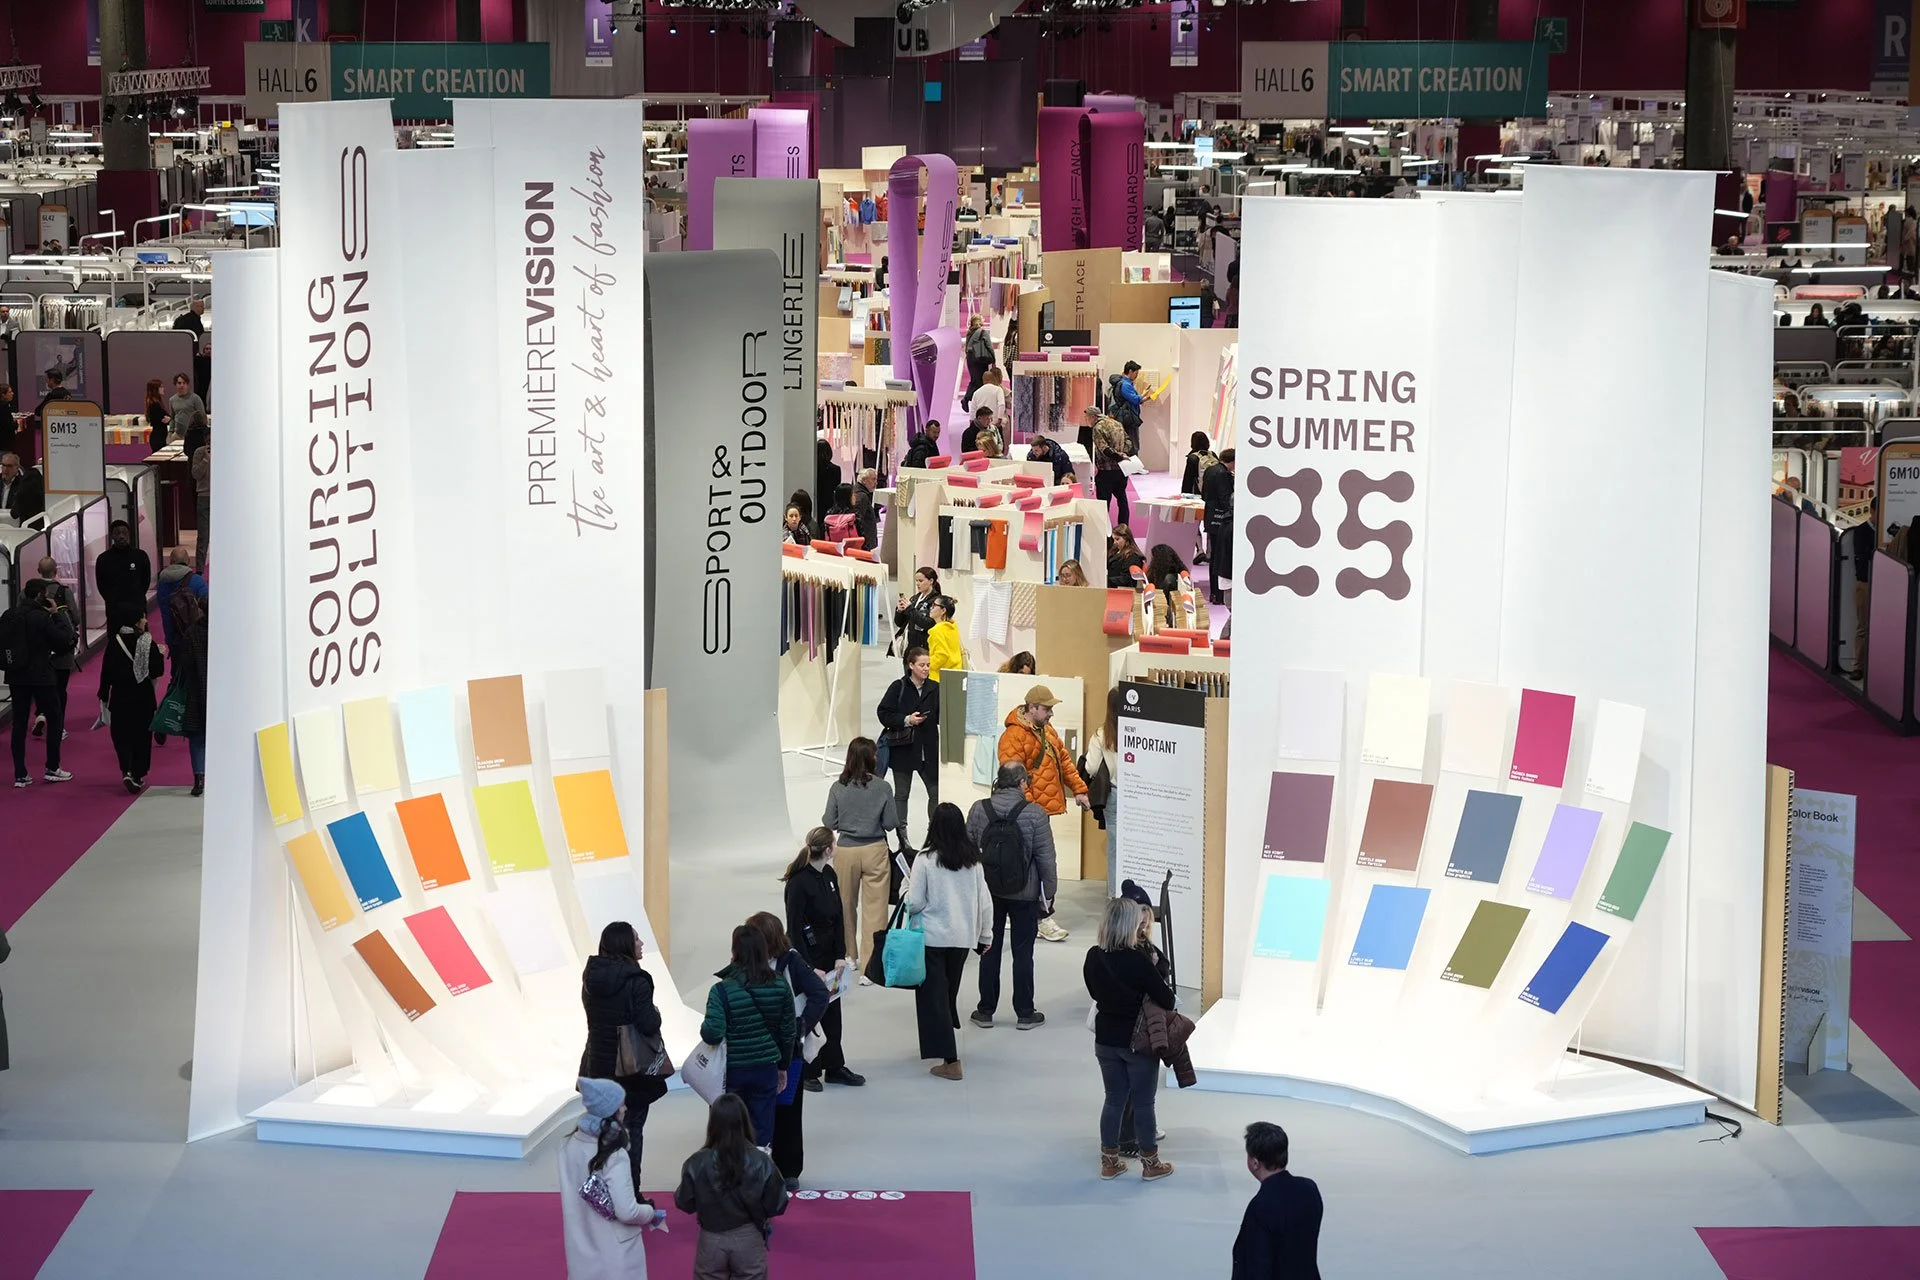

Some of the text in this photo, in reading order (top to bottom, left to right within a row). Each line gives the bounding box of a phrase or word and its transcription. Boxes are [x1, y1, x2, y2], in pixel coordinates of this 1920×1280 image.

[297, 18, 313, 42] K
[593, 18, 604, 43] L
[898, 28, 929, 51] UB
[1884, 15, 1907, 56] R
[343, 68, 415, 93] SMART
[422, 68, 526, 93] CREATION
[1340, 67, 1412, 92] SMART
[1419, 67, 1523, 92] CREATION
[1071, 140, 1081, 201] FANCY
[570, 145, 617, 256] fashion
[934, 200, 953, 306] LACES
[573, 264, 617, 296] of
[1075, 259, 1086, 330] ETPLACE
[783, 233, 804, 389] LINGERIE
[571, 287, 613, 382] heart
[1249, 366, 1416, 404] SPRING
[341, 145, 382, 678] SOLUTIONS
[585, 394, 607, 418] &
[50, 422, 77, 434] 6M13
[577, 411, 606, 475] art
[739, 330, 767, 524] OUTDOOR
[1248, 415, 1415, 452] SUMMER
[308, 275, 342, 688] SOURCING
[1889, 466, 1920, 480] 6M10
[1123, 704, 1141, 713] PARIS
[1124, 725, 1137, 734] NEW!
[1124, 735, 1177, 755] IMPORTANT
[1792, 809, 1839, 823] olor Book
